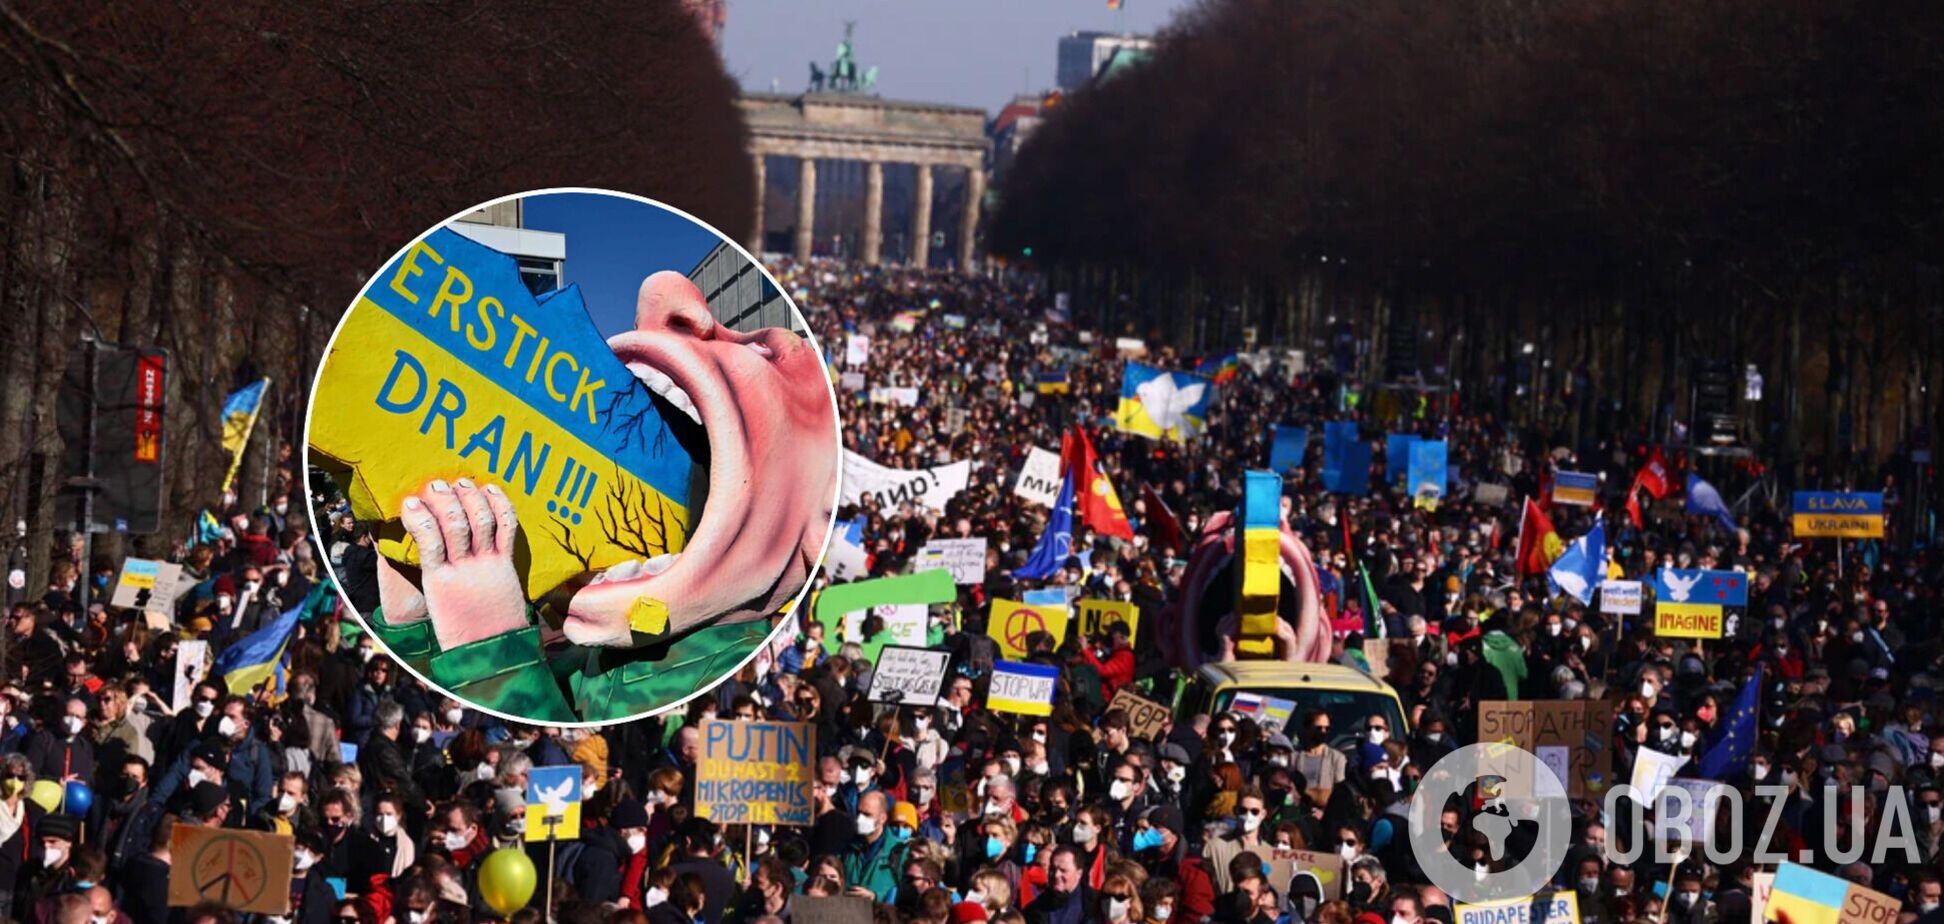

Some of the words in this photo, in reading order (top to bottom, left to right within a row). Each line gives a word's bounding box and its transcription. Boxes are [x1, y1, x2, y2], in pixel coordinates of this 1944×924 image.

[389, 240, 606, 424] ERSTICK
[144, 368, 155, 424] ZEPPEIN
[1022, 475, 1060, 497] ми
[1808, 497, 1868, 510] SLAVA
[1659, 612, 1719, 632] IMAGINE
[990, 674, 1029, 698] STOP
[1113, 695, 1167, 729] STOP
[1484, 709, 1535, 734] STOP
[1560, 710, 1607, 733] THIS
[707, 722, 809, 768] PUTIN
[698, 779, 808, 807] MIKROPENIS
[710, 802, 748, 821] STOP
[1272, 849, 1316, 863] PEACE
[1463, 899, 1570, 924] BUDAPESTER
[1845, 893, 1900, 922] STOP
